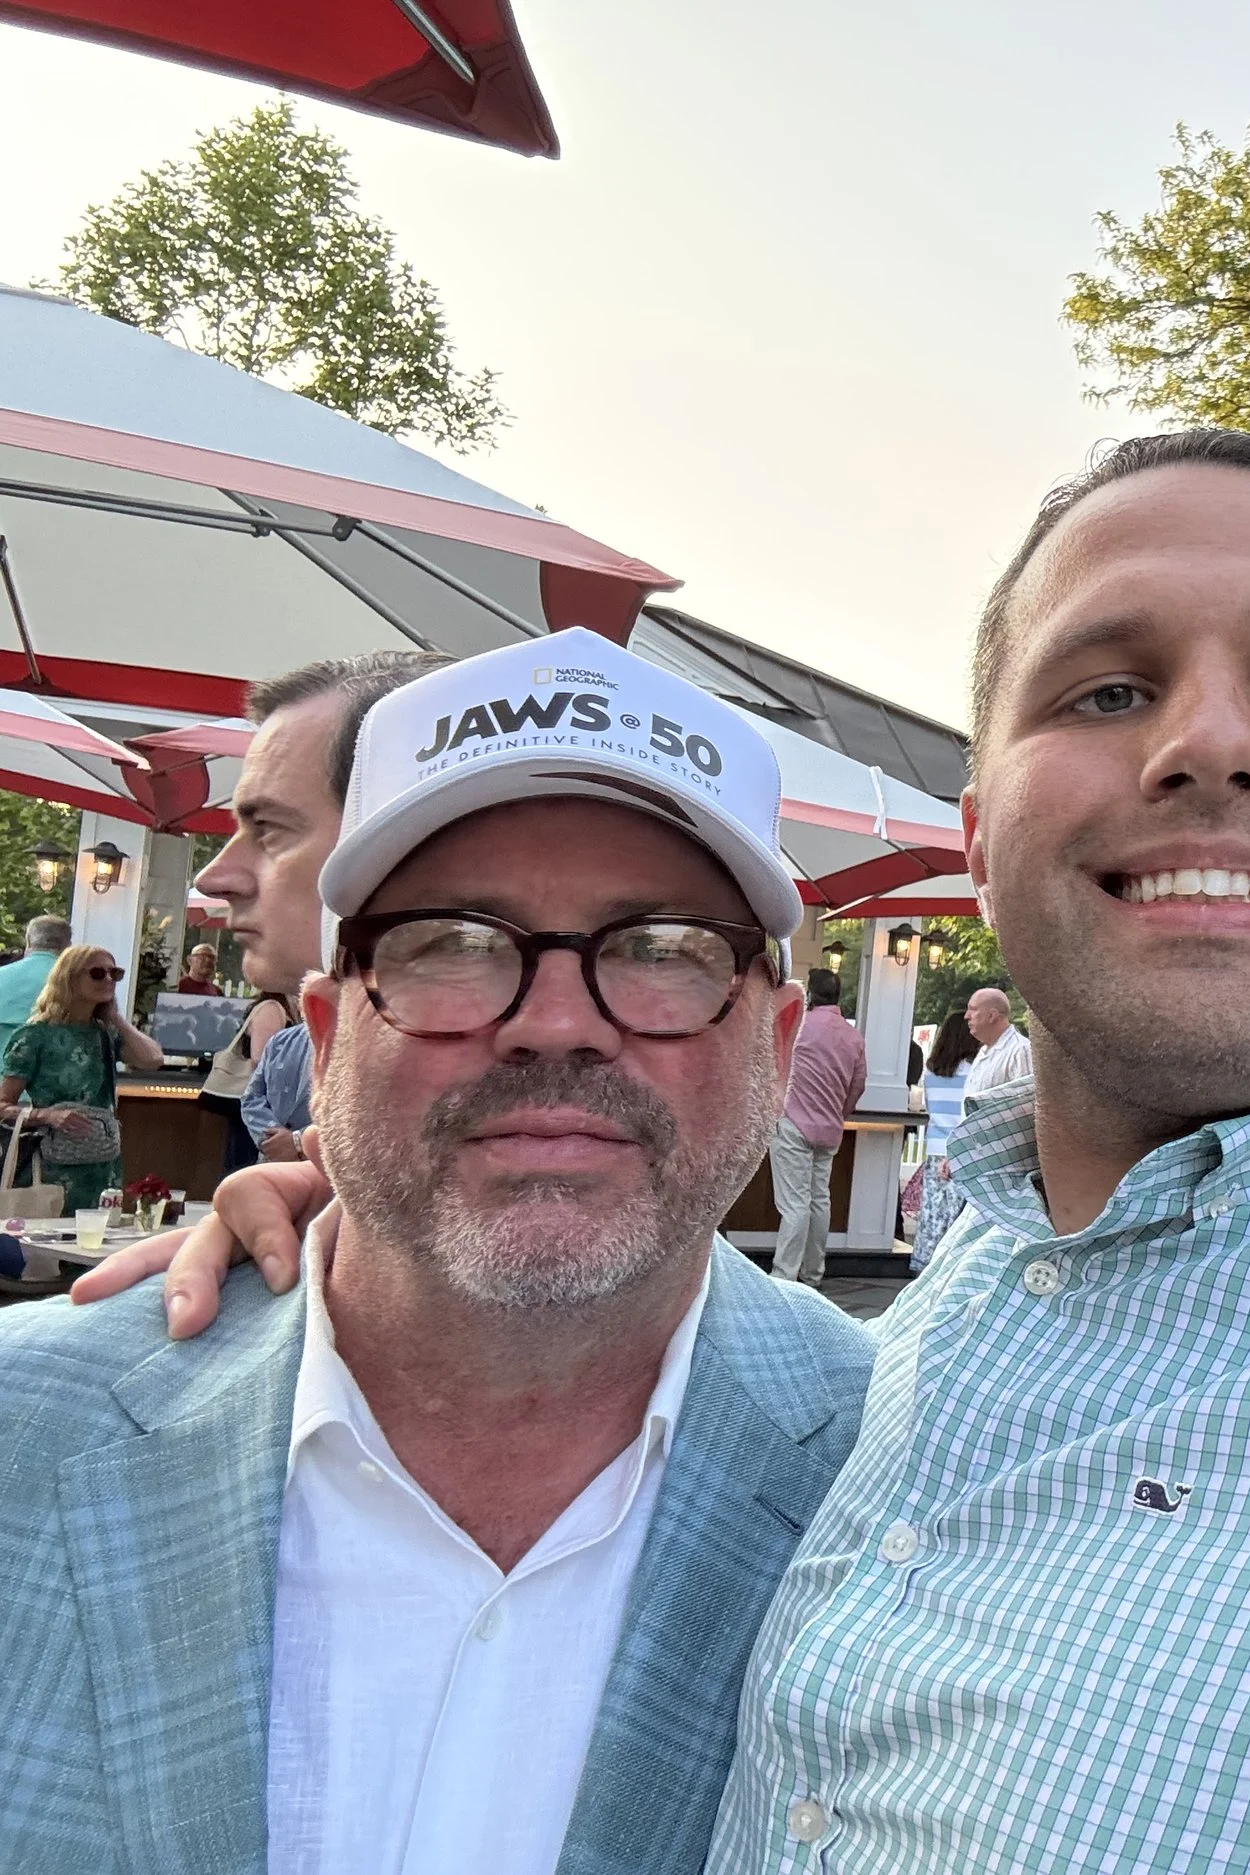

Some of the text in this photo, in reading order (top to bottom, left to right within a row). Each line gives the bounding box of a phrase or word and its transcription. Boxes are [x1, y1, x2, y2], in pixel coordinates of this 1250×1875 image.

[555, 675, 620, 691] GEOGRAPHIC
[556, 668, 606, 681] NATIONAL
[415, 692, 723, 777] JAWS @ 50
[417, 735, 722, 797] THE DEFINITIVE INSIDE STORY
